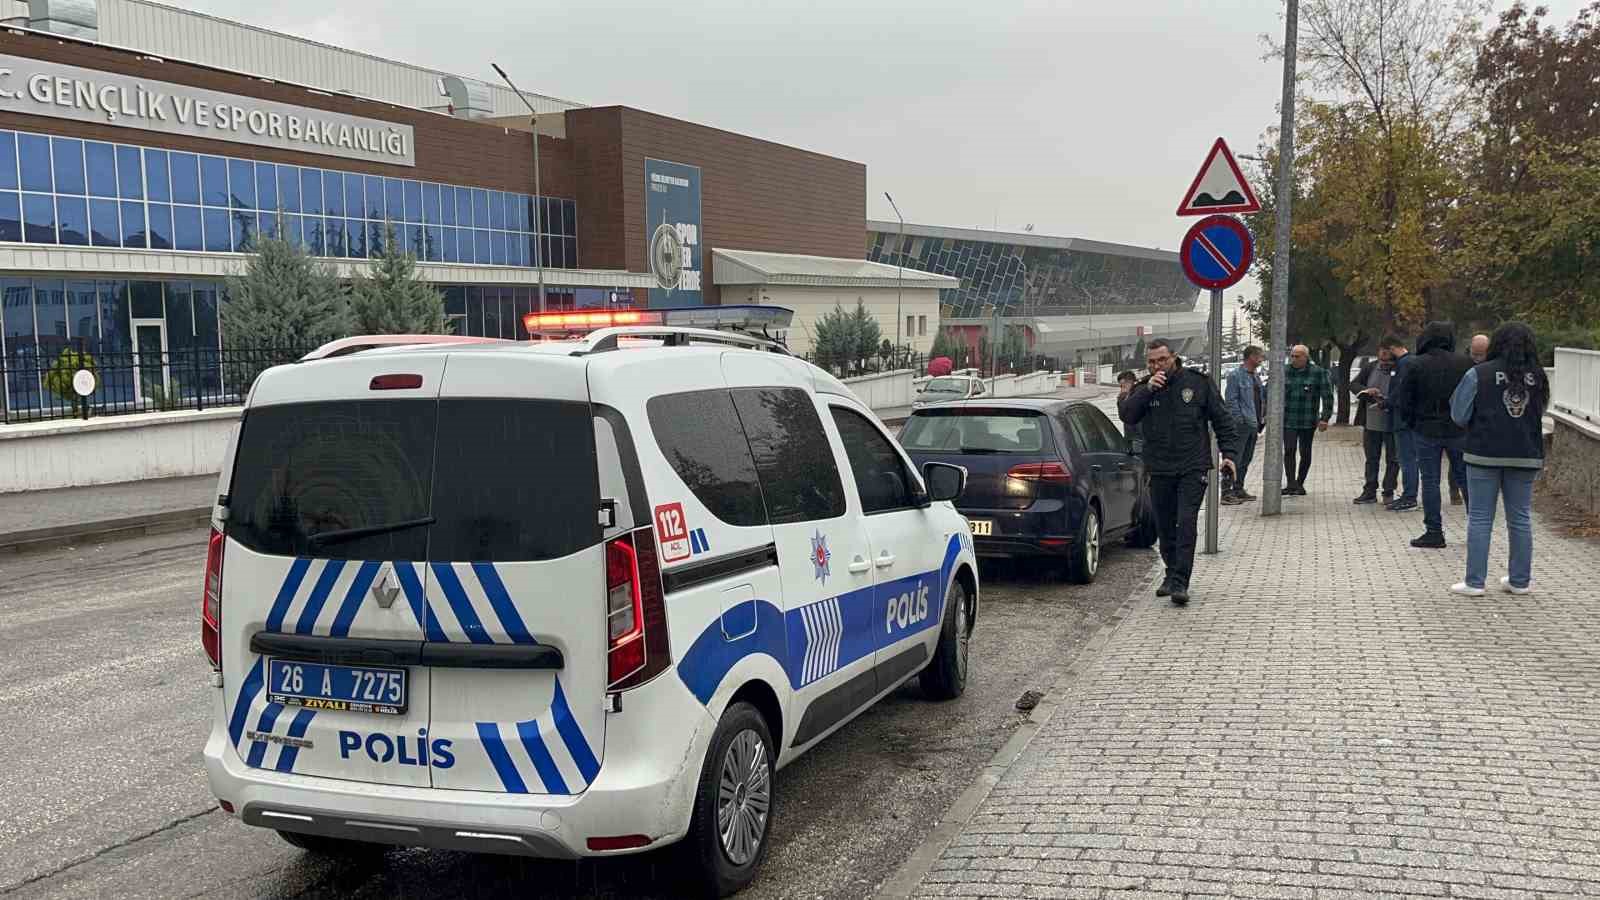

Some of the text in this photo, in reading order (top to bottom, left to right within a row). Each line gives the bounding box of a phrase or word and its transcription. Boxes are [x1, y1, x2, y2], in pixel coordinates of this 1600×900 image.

[28, 73, 167, 121] GENÇLİK
[172, 95, 209, 127] VE
[214, 102, 282, 138] SPOR
[288, 113, 408, 157] BAKANLIĞI
[659, 509, 684, 537] 112
[886, 579, 929, 634] POLİS
[281, 664, 402, 701] 26 A 7275
[338, 727, 456, 769] POLİS
